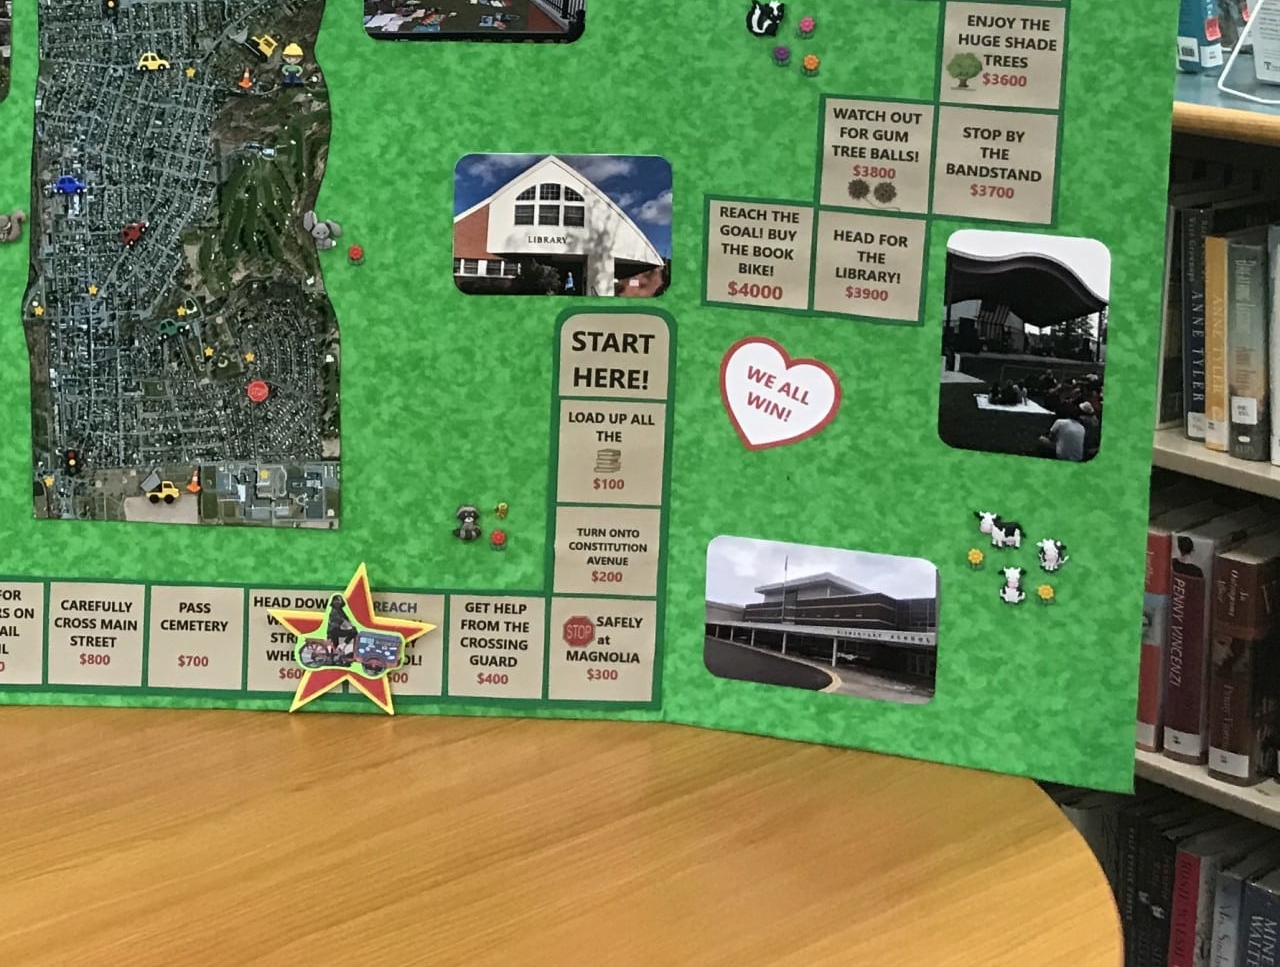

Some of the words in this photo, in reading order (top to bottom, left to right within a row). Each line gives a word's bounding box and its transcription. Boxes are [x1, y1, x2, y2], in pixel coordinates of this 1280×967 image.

[964, 127, 1001, 140] STOP
[1006, 131, 1024, 142] BY
[981, 147, 1009, 160] THE
[947, 163, 1041, 182] BANDSTAND
[971, 184, 1014, 199] $3700
[1192, 290, 1204, 338] ANNE
[1212, 296, 1223, 342] ANNE
[572, 331, 655, 354] START
[574, 367, 648, 390] HERE!
[1192, 347, 1205, 402] TYLER
[1212, 344, 1224, 394] TYLER
[748, 366, 776, 389] WE
[778, 382, 808, 405] ALL
[748, 392, 791, 422] WIN!
[569, 412, 605, 423] LOAD
[609, 414, 627, 424] UP
[631, 414, 655, 425] ALL
[596, 431, 621, 442] THE
[594, 478, 624, 490] $100
[180, 603, 210, 613] PASS
[1172, 578, 1186, 624] PENNY
[161, 620, 228, 631] CEMETERY
[566, 622, 593, 639] STOP
[596, 617, 643, 628] SAFELY
[598, 636, 610, 645] at
[178, 655, 208, 667] $700
[567, 651, 640, 663] MAGNOLIA
[1169, 625, 1184, 688] VINCENZI
[587, 668, 618, 681] $300
[1247, 915, 1264, 967] WALTE
[1261, 918, 1278, 966] MINE
